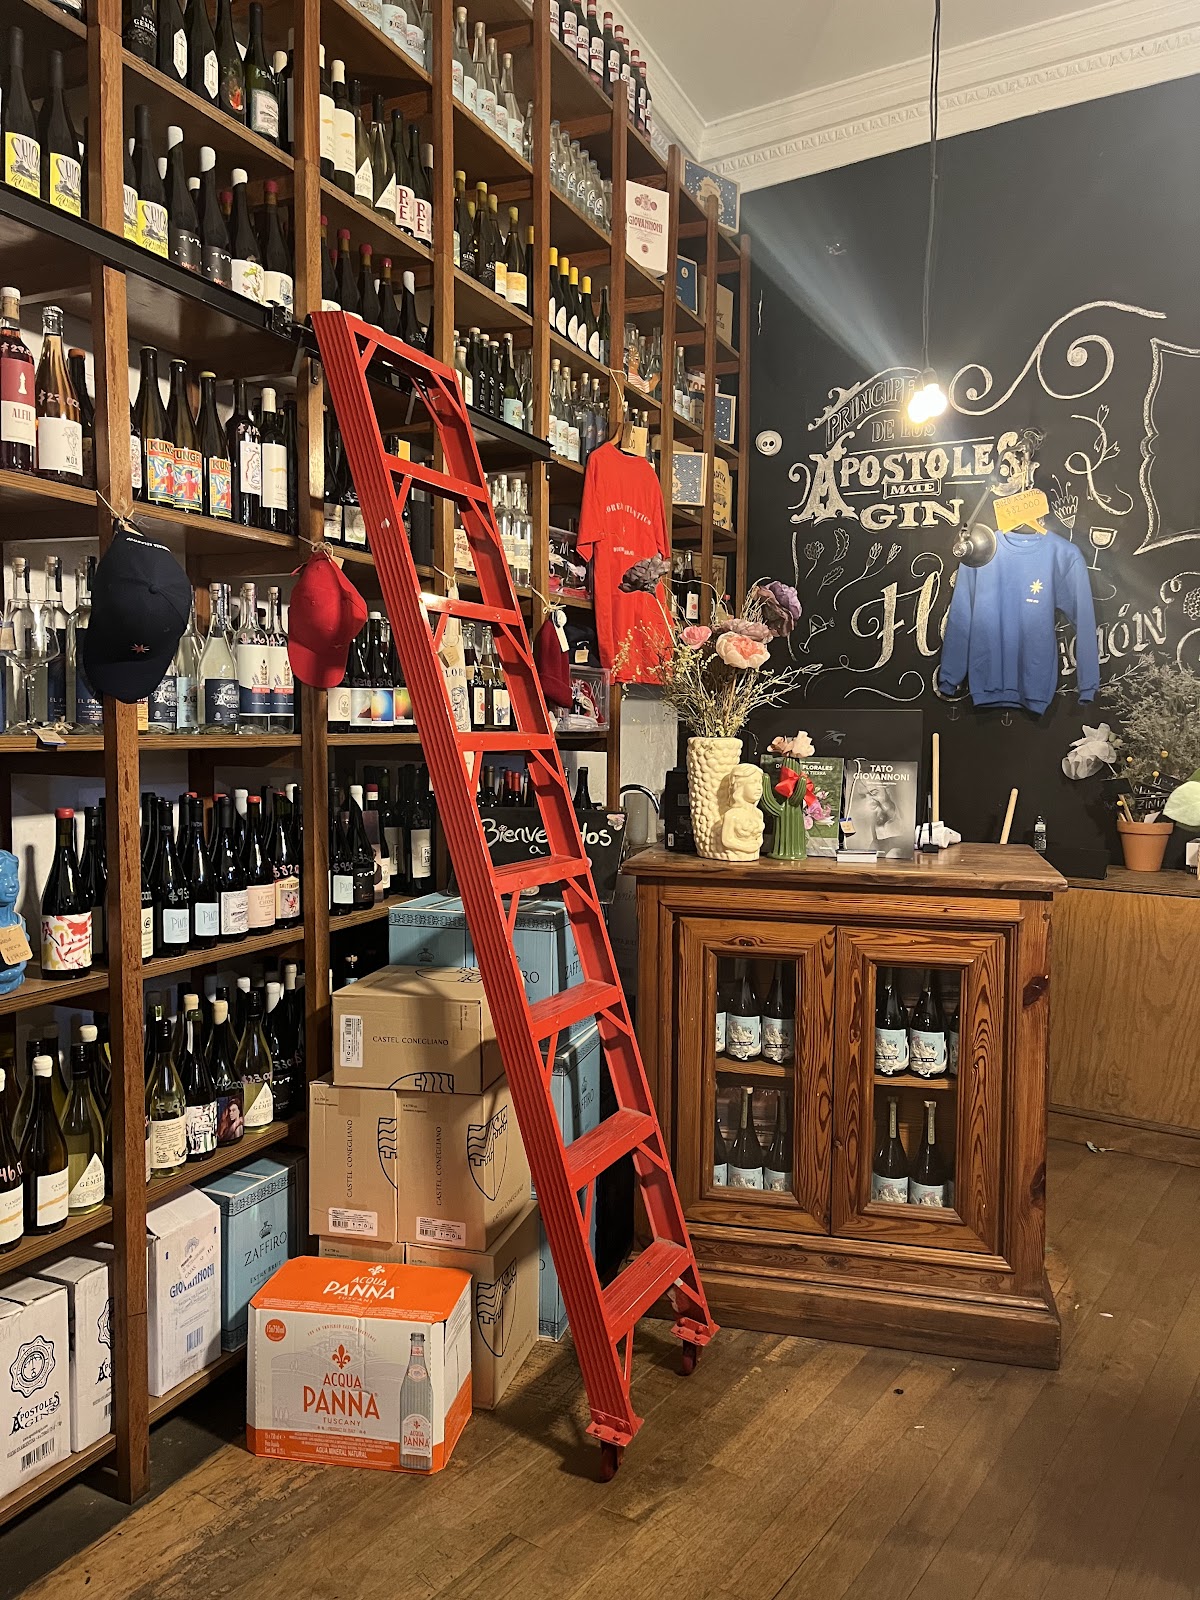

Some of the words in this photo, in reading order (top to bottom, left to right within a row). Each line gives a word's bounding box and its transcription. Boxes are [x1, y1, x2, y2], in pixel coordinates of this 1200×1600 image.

[628, 215, 663, 234] GIOVANNONI
[12, 407, 32, 423] ALFIL
[871, 419, 895, 443] DE
[889, 482, 937, 496] MATE
[859, 498, 965, 534] GIN
[853, 772, 911, 782] GIOVANNONI
[869, 764, 894, 774] TATO
[372, 1035, 400, 1044] CASTEL
[401, 1035, 449, 1047] CONEGLIANO
[244, 1230, 288, 1268] ZAFFIRO
[322, 1280, 396, 1300] PANNA
[350, 1276, 388, 1287] ACQUA
[322, 1372, 363, 1389] ACQUA
[303, 1385, 381, 1420] PANNA
[8, 1390, 61, 1437] APOSTOLES
[24, 1411, 49, 1428] GIN
[322, 1416, 362, 1427] TUSCANY
[403, 1435, 430, 1448] PANNA
